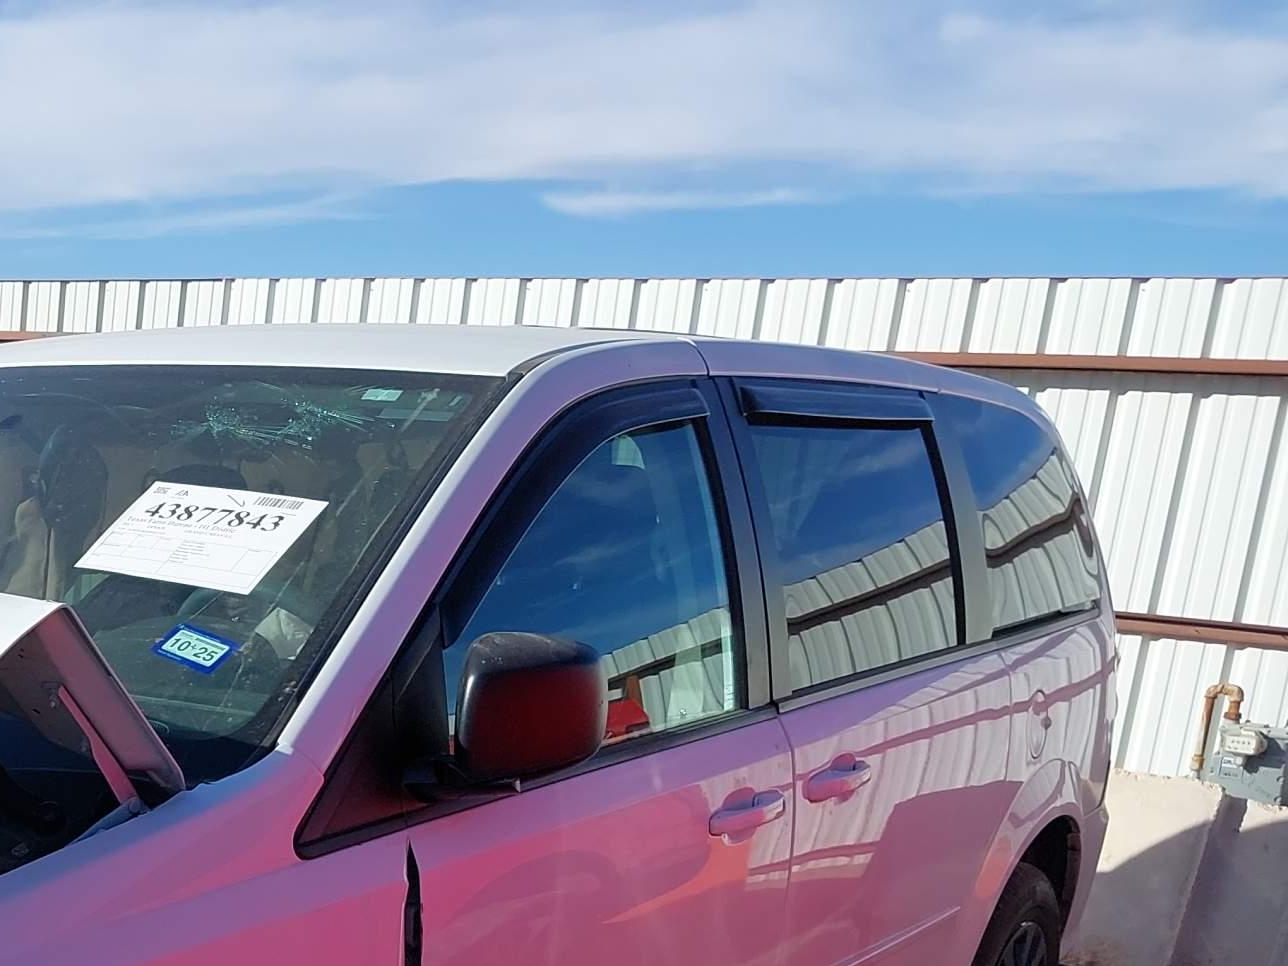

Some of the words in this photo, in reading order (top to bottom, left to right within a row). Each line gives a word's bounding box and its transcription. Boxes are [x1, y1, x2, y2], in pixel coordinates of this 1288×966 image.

[145, 502, 285, 532] 43877843
[170, 638, 192, 652] 10
[192, 647, 219, 662] 25
